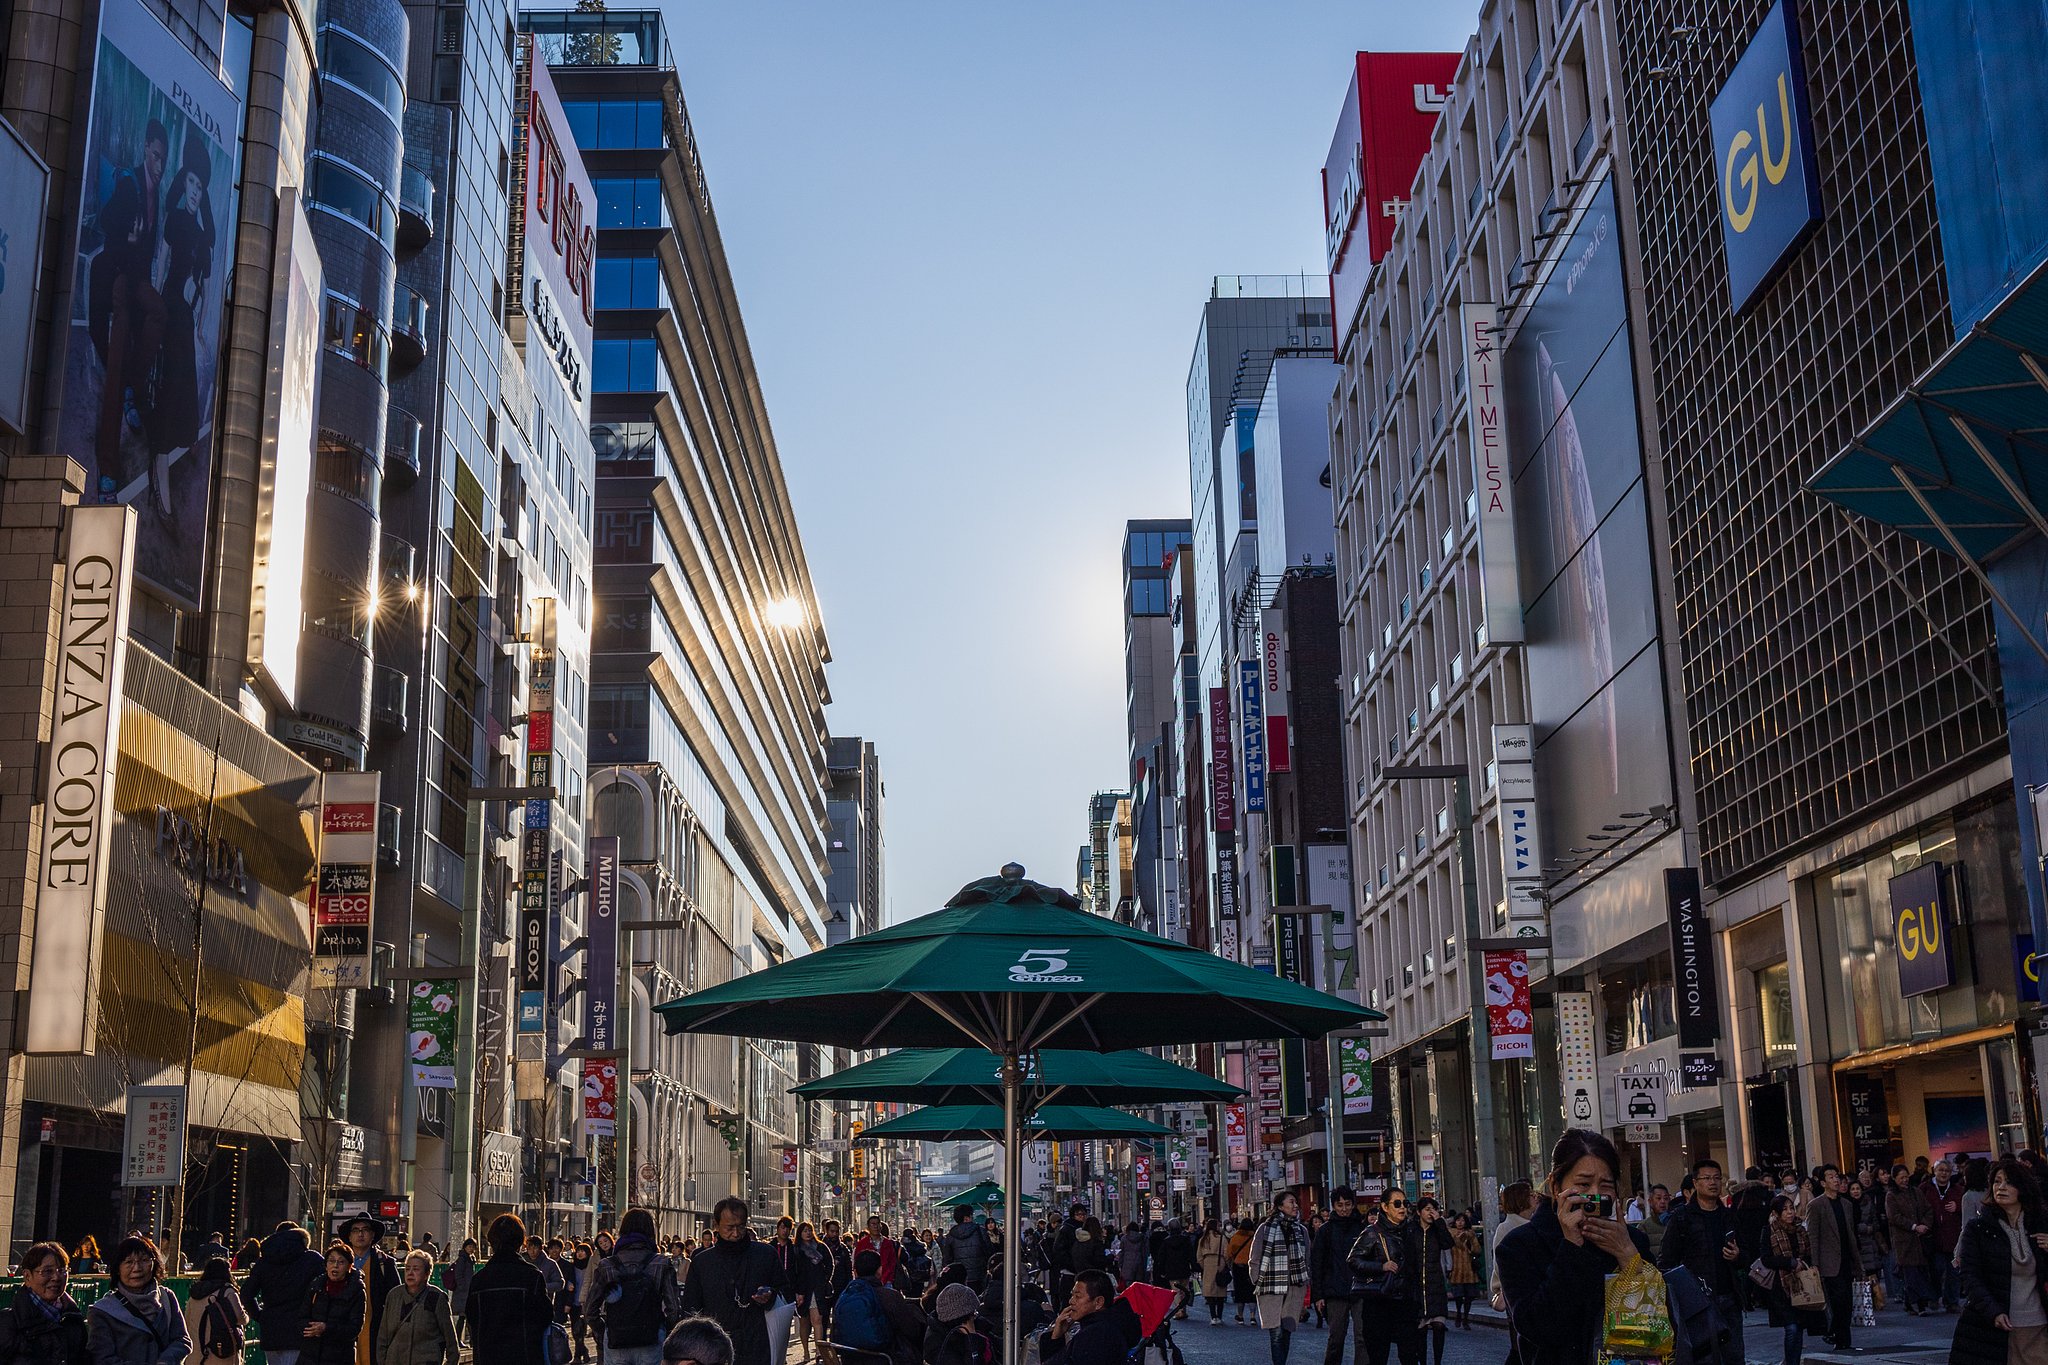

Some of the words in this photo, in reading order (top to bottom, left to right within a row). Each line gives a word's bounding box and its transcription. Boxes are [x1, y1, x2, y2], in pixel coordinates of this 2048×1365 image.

[171, 79, 224, 145] PRADA
[1725, 72, 1792, 233] GU
[532, 90, 597, 328] THK
[1571, 244, 1594, 286] iPhone
[1474, 321, 1504, 513] EXITMELSA
[61, 554, 114, 726] GINZA
[1266, 632, 1279, 692] docomo
[307, 727, 326, 740] Gold
[531, 757, 547, 787] 歯科
[1215, 750, 1231, 820] NATARAJ
[46, 740, 99, 890] CORE
[1249, 796, 1264, 807] 6F
[1219, 850, 1232, 858] 6F
[1513, 809, 1529, 871] PLAZA
[1327, 859, 1348, 868] 世界
[1327, 872, 1349, 881] 現地
[527, 882, 544, 908] 歯科
[599, 855, 612, 917] MIZUHO
[328, 898, 367, 913] ECC
[323, 936, 362, 945] PRADA
[1898, 902, 1940, 962] GU
[528, 919, 540, 982] GEOX
[1009, 949, 1071, 975] 5
[1679, 898, 1701, 1017] WASHINGTON
[1008, 972, 1084, 983] Ginza
[476, 988, 502, 1095] FANCL
[1496, 1042, 1529, 1051] RICOH
[1621, 1077, 1660, 1090] TAXI
[1685, 1065, 1715, 1073] ワシントン
[169, 1098, 177, 1132] この通りは
[1851, 1093, 1869, 1106] 5F
[146, 1102, 158, 1174] 車両通行禁止
[156, 1102, 169, 1174] 大震災等発生時
[1855, 1125, 1872, 1138] 4F
[138, 1143, 146, 1177] になります
[489, 1149, 514, 1173] GEOX
[1858, 1158, 1875, 1172] 3F
